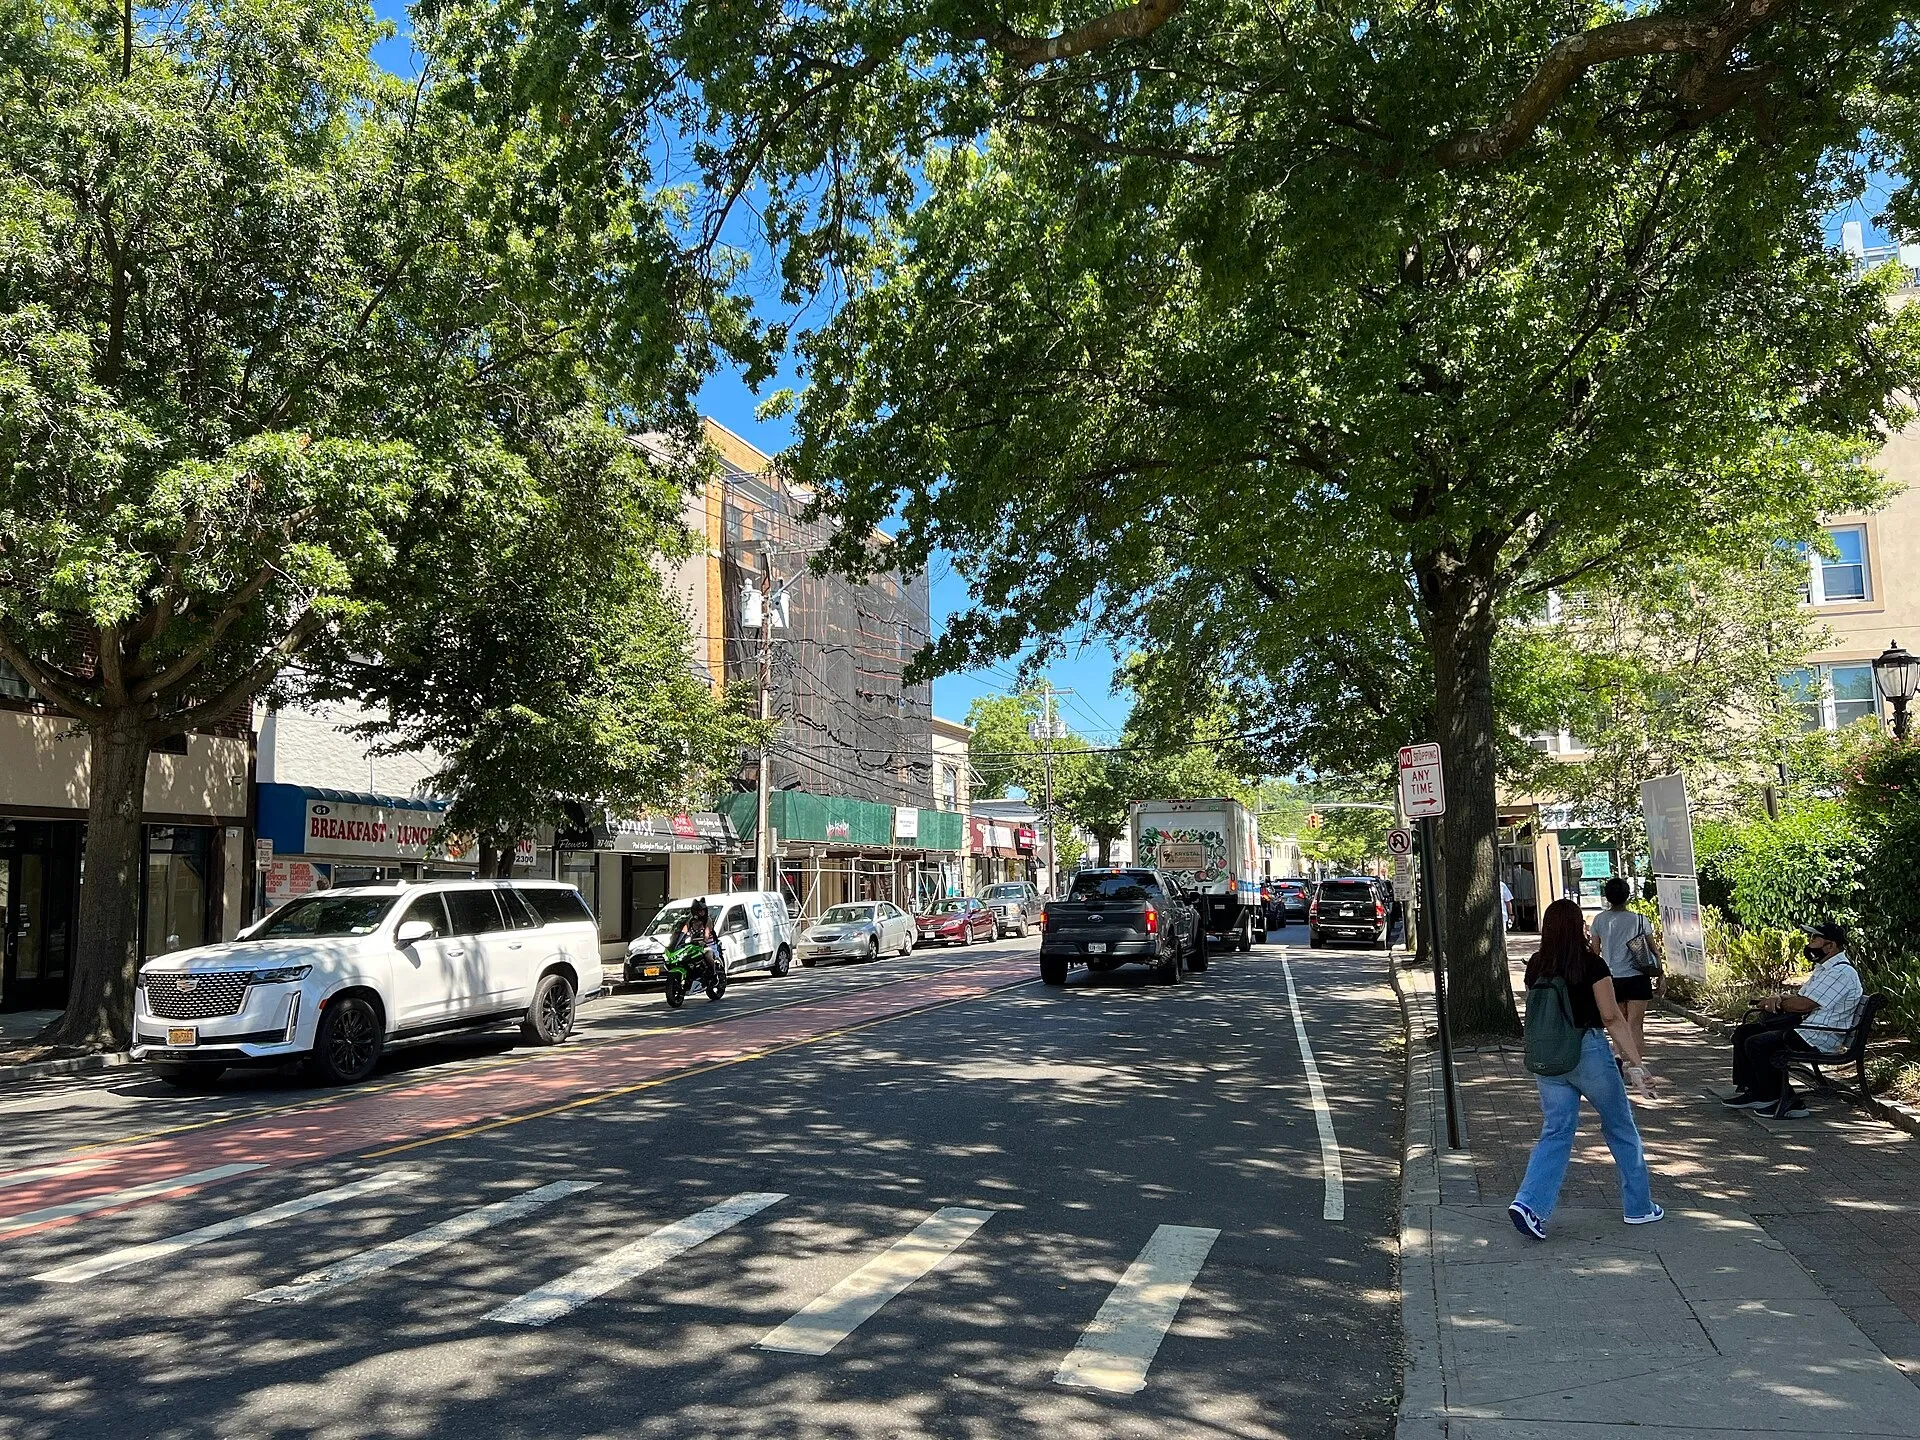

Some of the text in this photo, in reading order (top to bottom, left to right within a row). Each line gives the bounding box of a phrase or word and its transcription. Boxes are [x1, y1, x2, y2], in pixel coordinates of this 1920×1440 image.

[1400, 749, 1437, 766] NO STOPPING
[1412, 769, 1430, 782] ANY
[1411, 782, 1434, 795] TIME
[315, 806, 327, 815] 61
[310, 816, 387, 843] BREAKFAST
[516, 855, 534, 863] 2300
